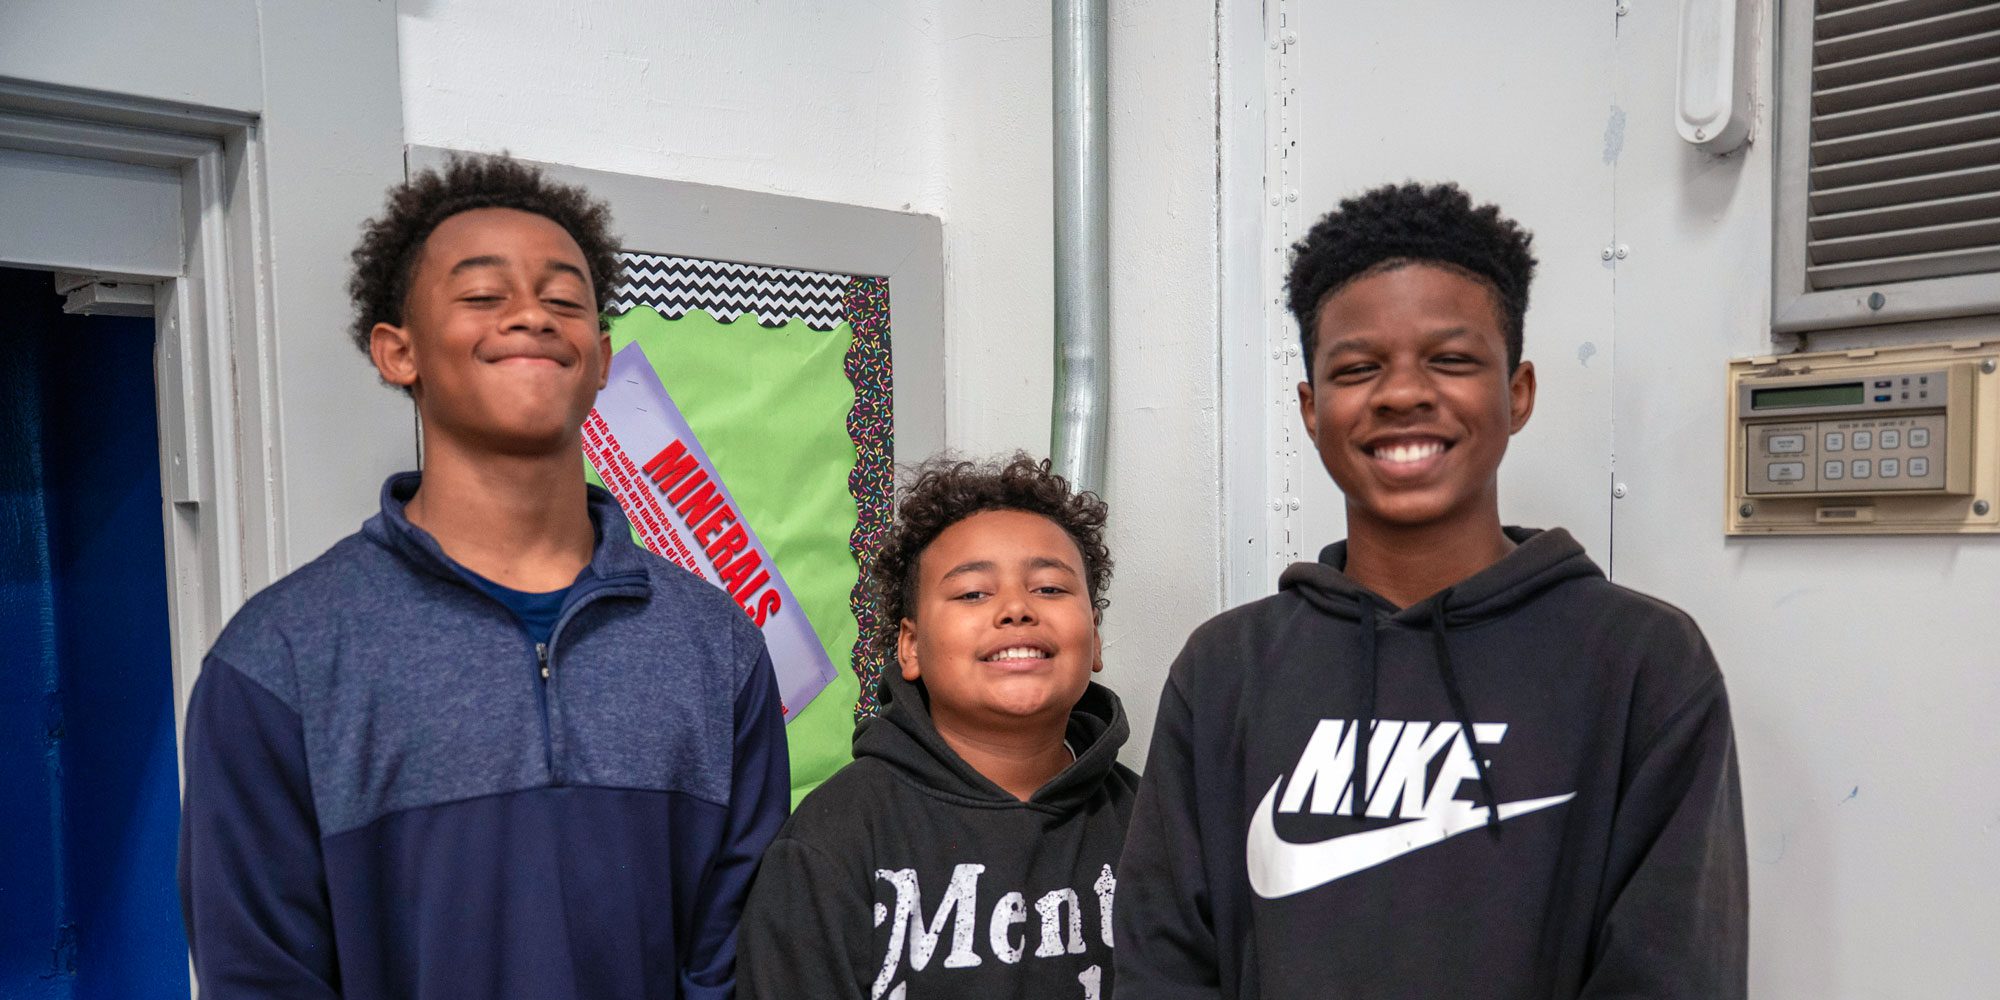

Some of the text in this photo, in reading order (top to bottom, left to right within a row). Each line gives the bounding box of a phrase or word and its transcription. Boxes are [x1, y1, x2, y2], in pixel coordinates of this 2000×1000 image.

[599, 467, 620, 495] Here
[615, 492, 631, 511] are
[627, 509, 648, 538] some
[599, 446, 633, 493] Minerals
[627, 490, 644, 510] are
[639, 507, 662, 536] made
[656, 533, 670, 549] up
[665, 546, 678, 560] of
[604, 433, 622, 453] are
[617, 450, 639, 478] solid
[633, 475, 673, 532] substances
[667, 527, 691, 559] found
[685, 555, 697, 569] in
[641, 437, 782, 629] MINERALS
[1278, 719, 1508, 819] NIKE
